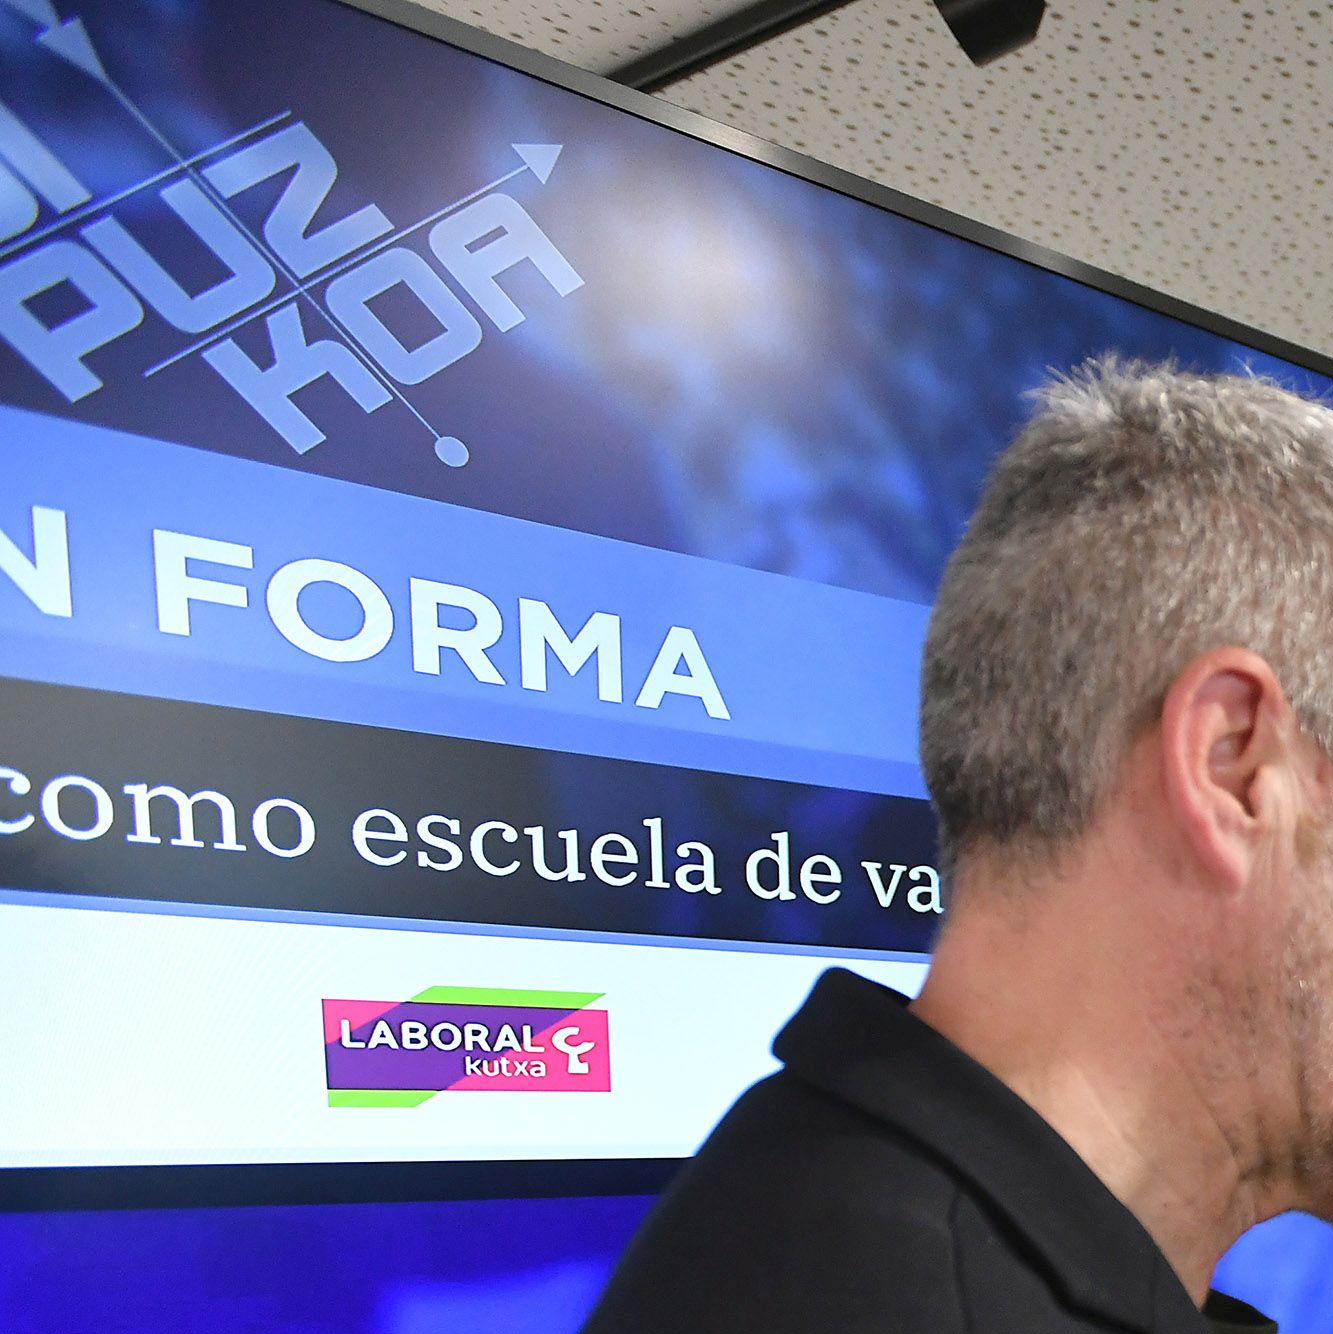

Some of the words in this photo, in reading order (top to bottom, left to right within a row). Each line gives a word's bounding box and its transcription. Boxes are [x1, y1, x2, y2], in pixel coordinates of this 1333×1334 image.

[0, 121, 394, 404] PUZ
[202, 193, 586, 455] KOA
[152, 528, 731, 721] FORMA
[351, 806, 721, 895] escuela
[746, 831, 842, 904] de
[340, 1019, 545, 1053] LABORAL
[464, 1056, 546, 1077] kutxa
